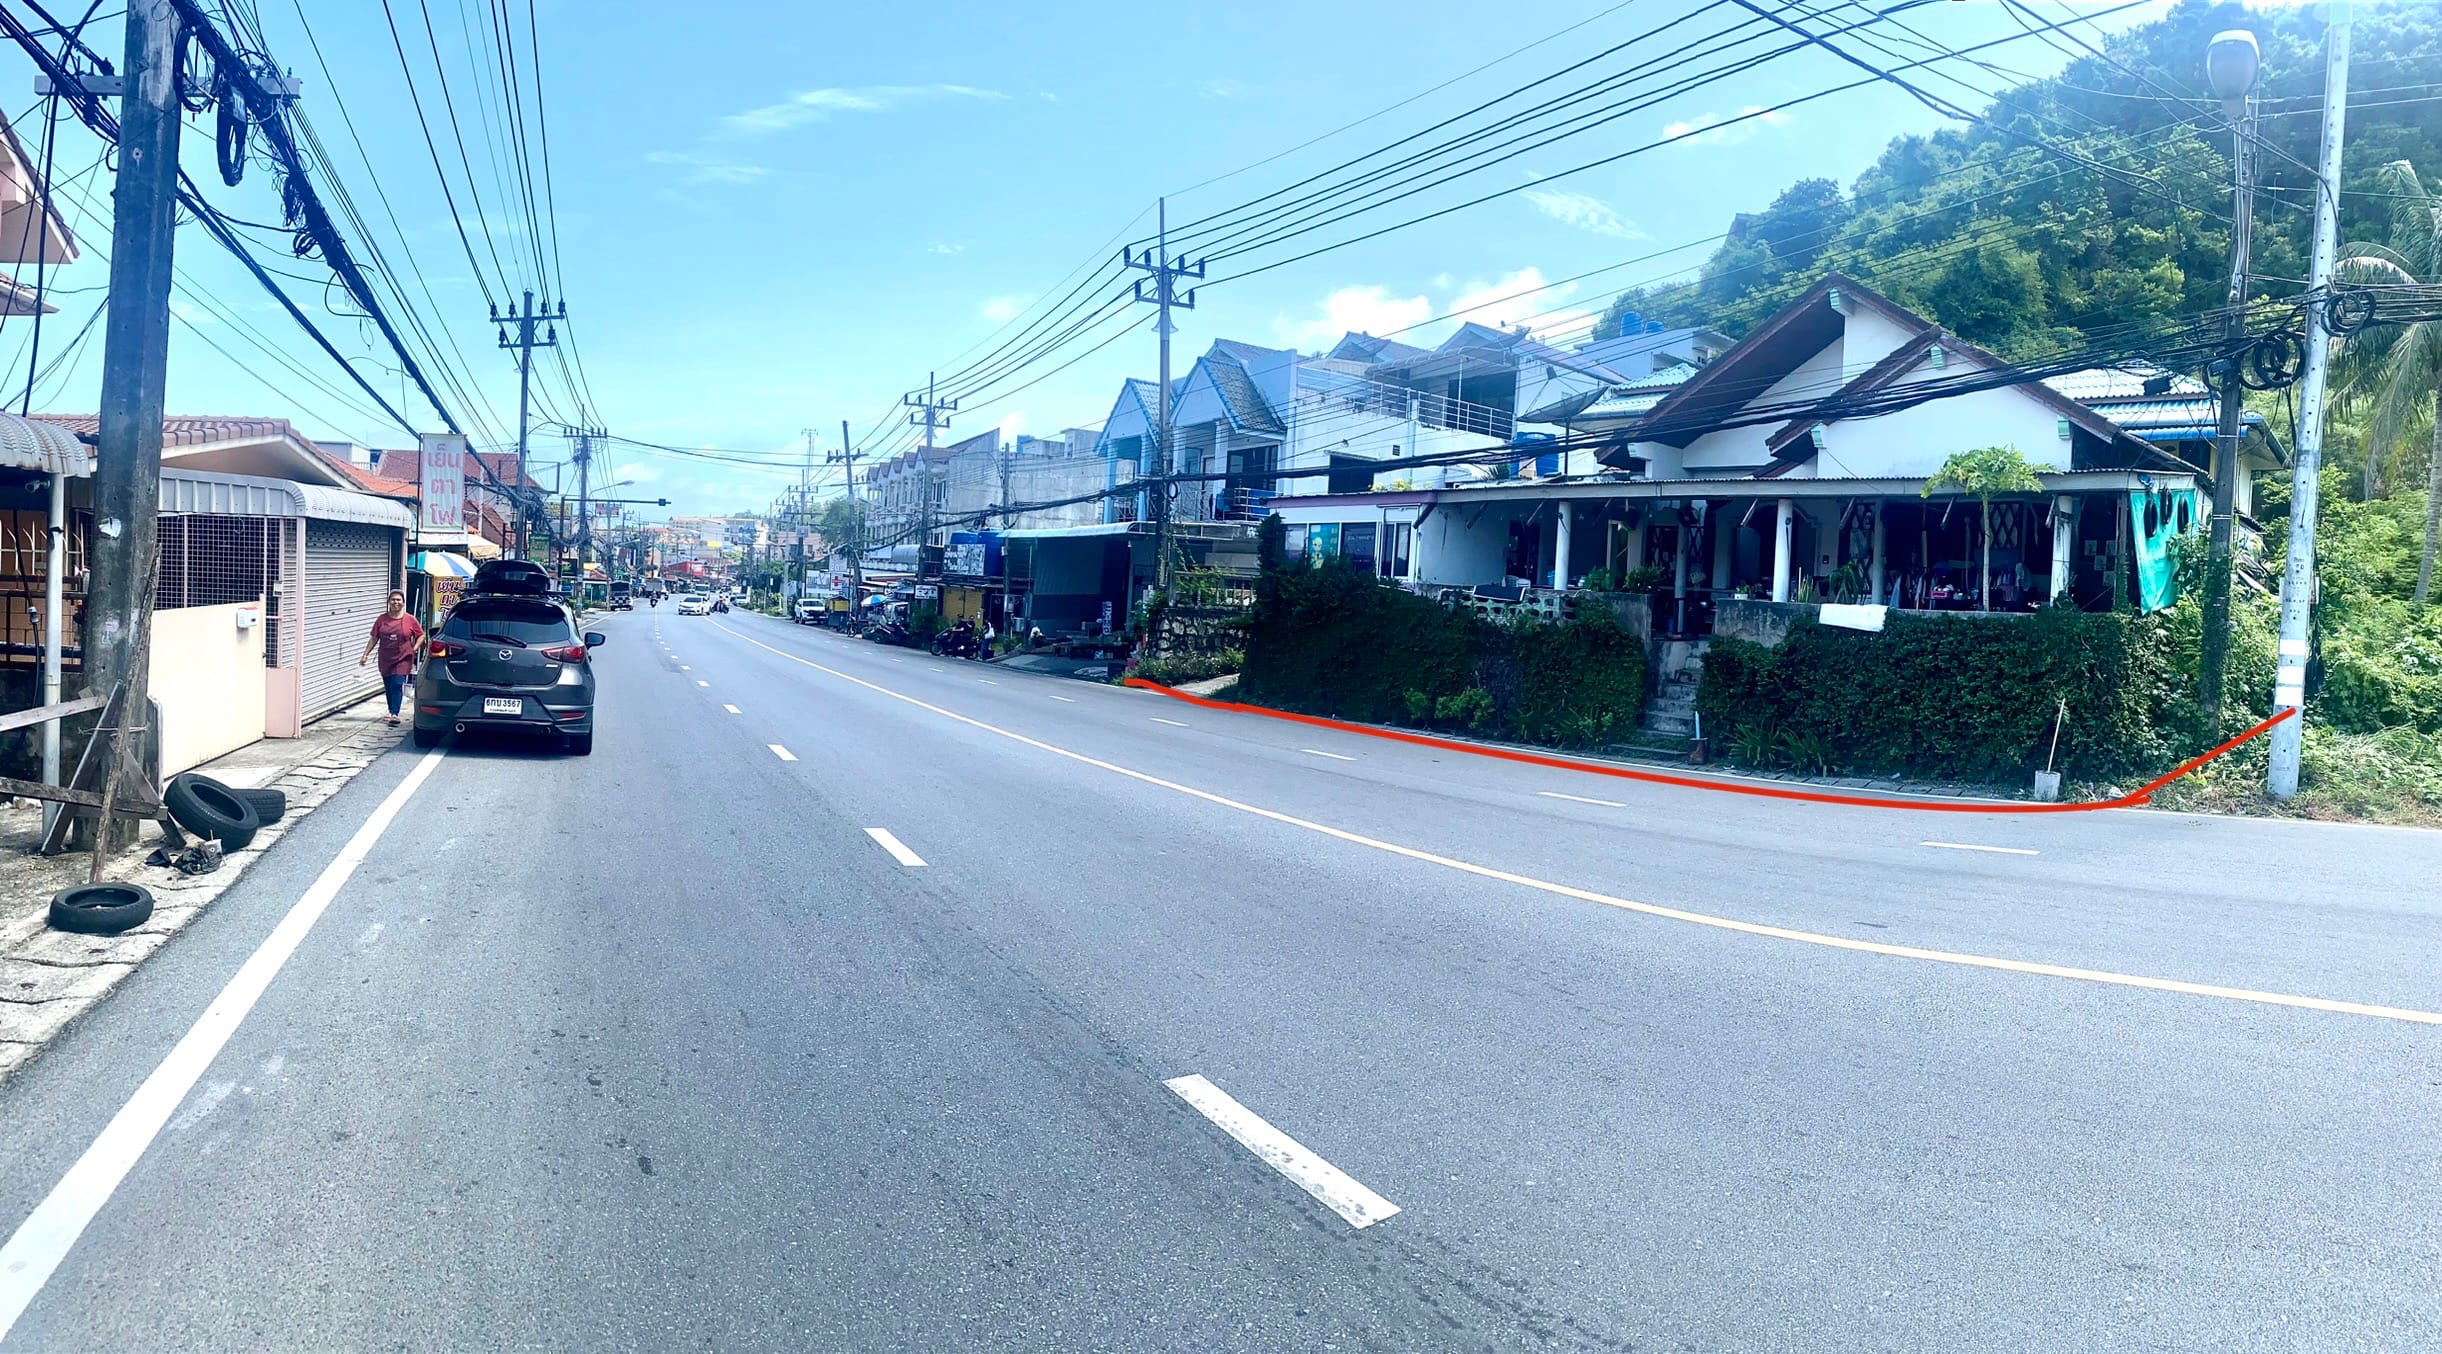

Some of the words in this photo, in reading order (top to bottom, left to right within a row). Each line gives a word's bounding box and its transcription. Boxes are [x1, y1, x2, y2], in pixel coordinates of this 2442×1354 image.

[428, 443, 460, 468] เย็น
[431, 478, 456, 494] ตา
[429, 503, 456, 525] โฟ
[503, 700, 520, 708] 3567
